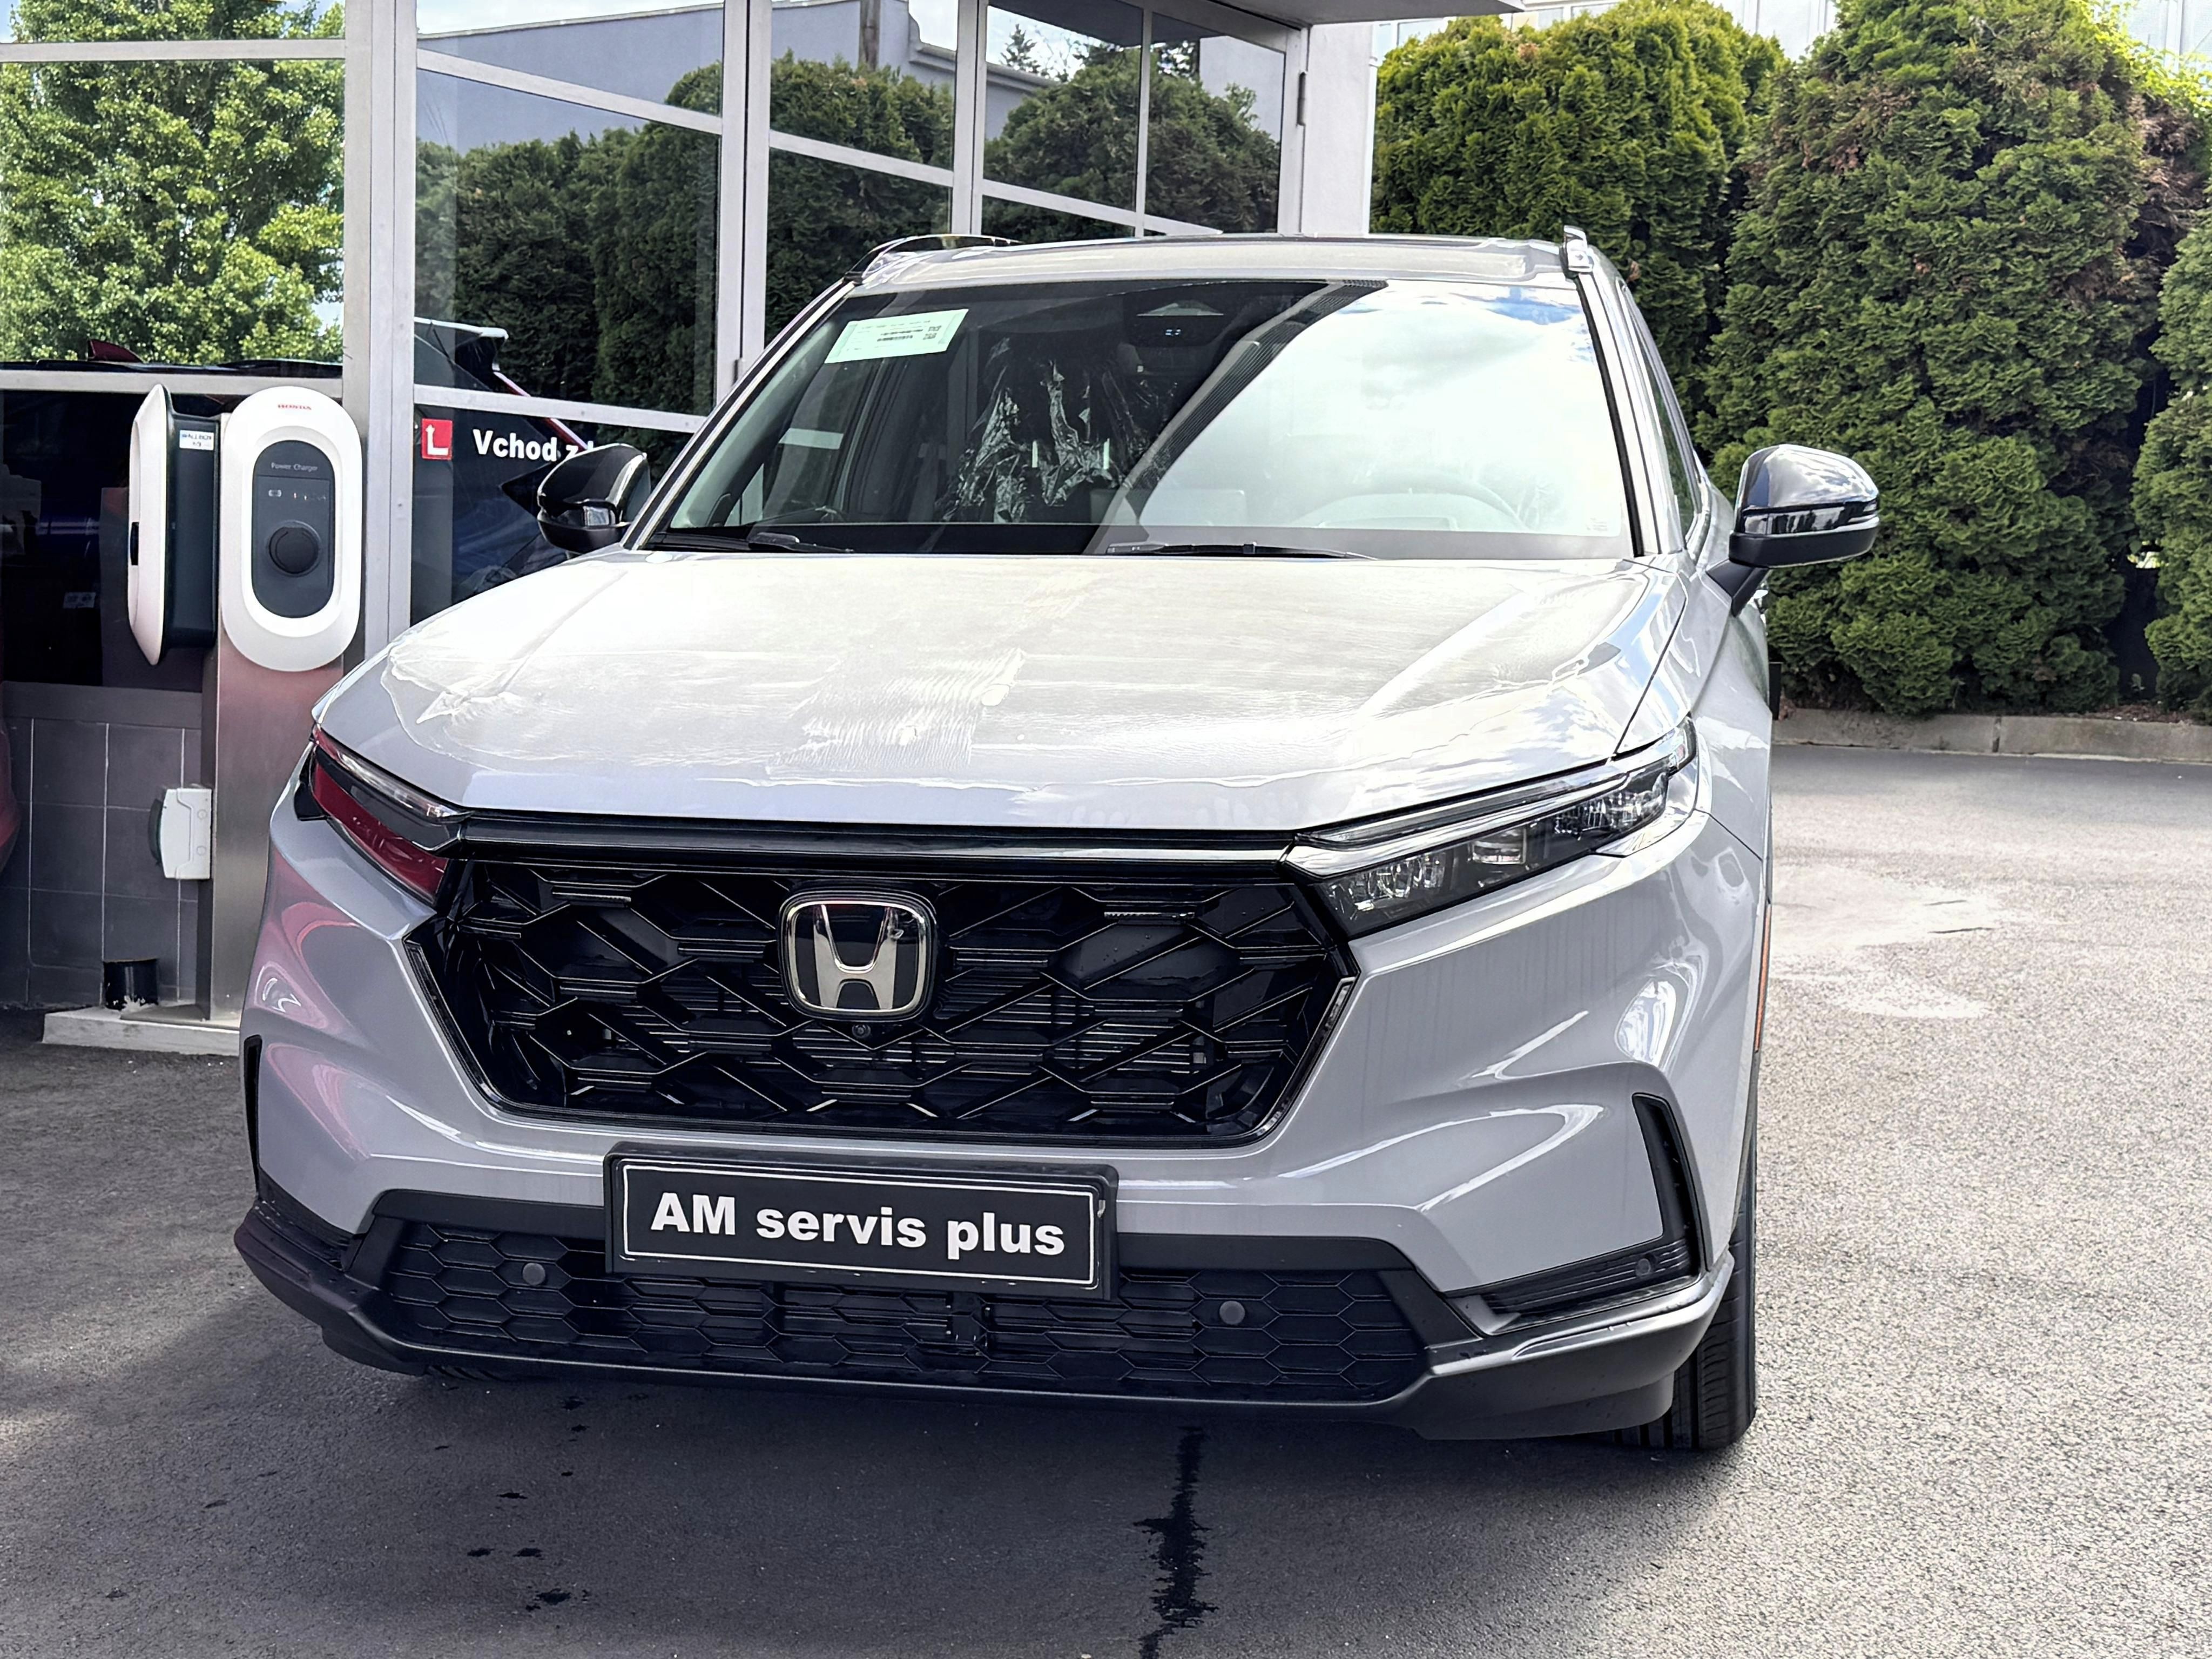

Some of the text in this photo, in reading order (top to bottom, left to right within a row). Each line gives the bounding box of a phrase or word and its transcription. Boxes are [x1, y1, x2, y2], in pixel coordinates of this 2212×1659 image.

[473, 429, 557, 462] Vchod
[651, 1192, 1064, 1260] AM servis plus
